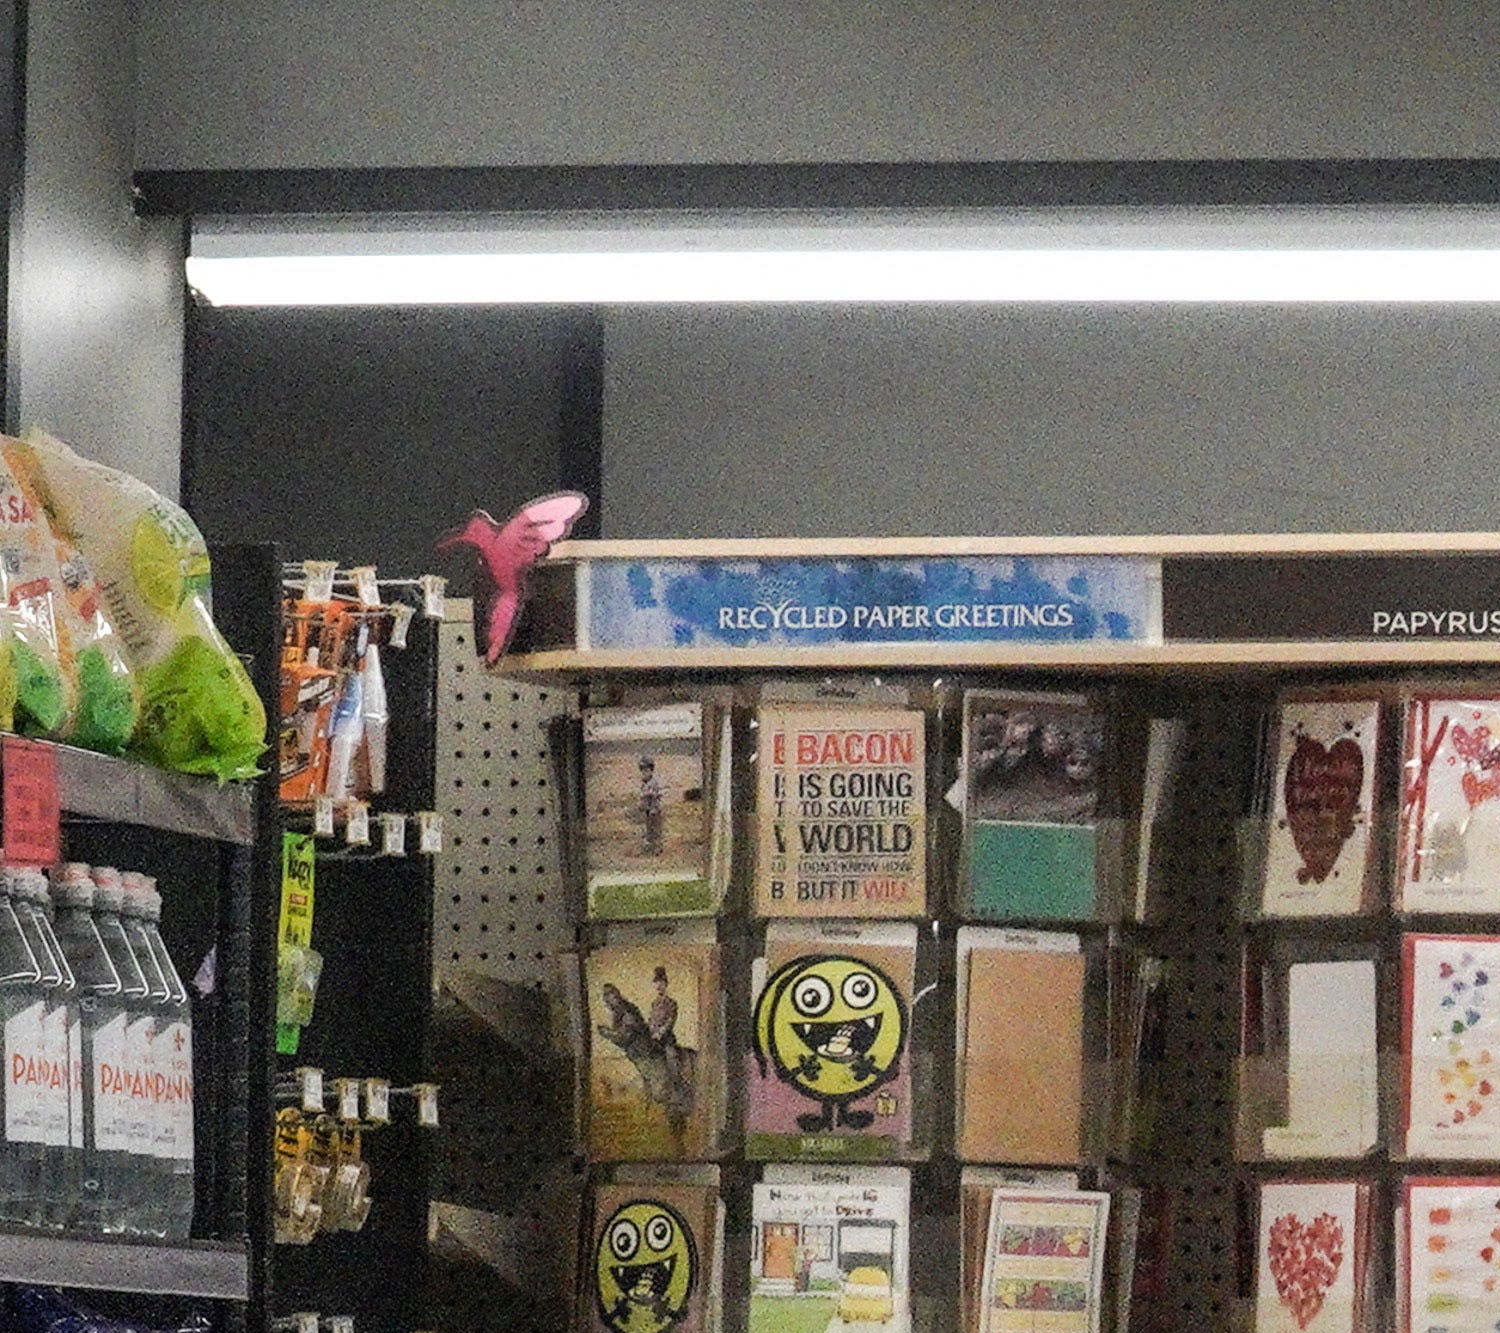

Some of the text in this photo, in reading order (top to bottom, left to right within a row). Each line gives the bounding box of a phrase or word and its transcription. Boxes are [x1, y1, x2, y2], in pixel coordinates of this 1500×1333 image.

[718, 603, 1073, 629] RECYCLED PAPER GREETINGS
[797, 733, 913, 766] BACON
[799, 772, 913, 799] IS GOING
[802, 799, 910, 818] TO SAVE THE
[798, 823, 912, 854] WORLD
[797, 879, 835, 901] BUT
[841, 879, 857, 901] IT
